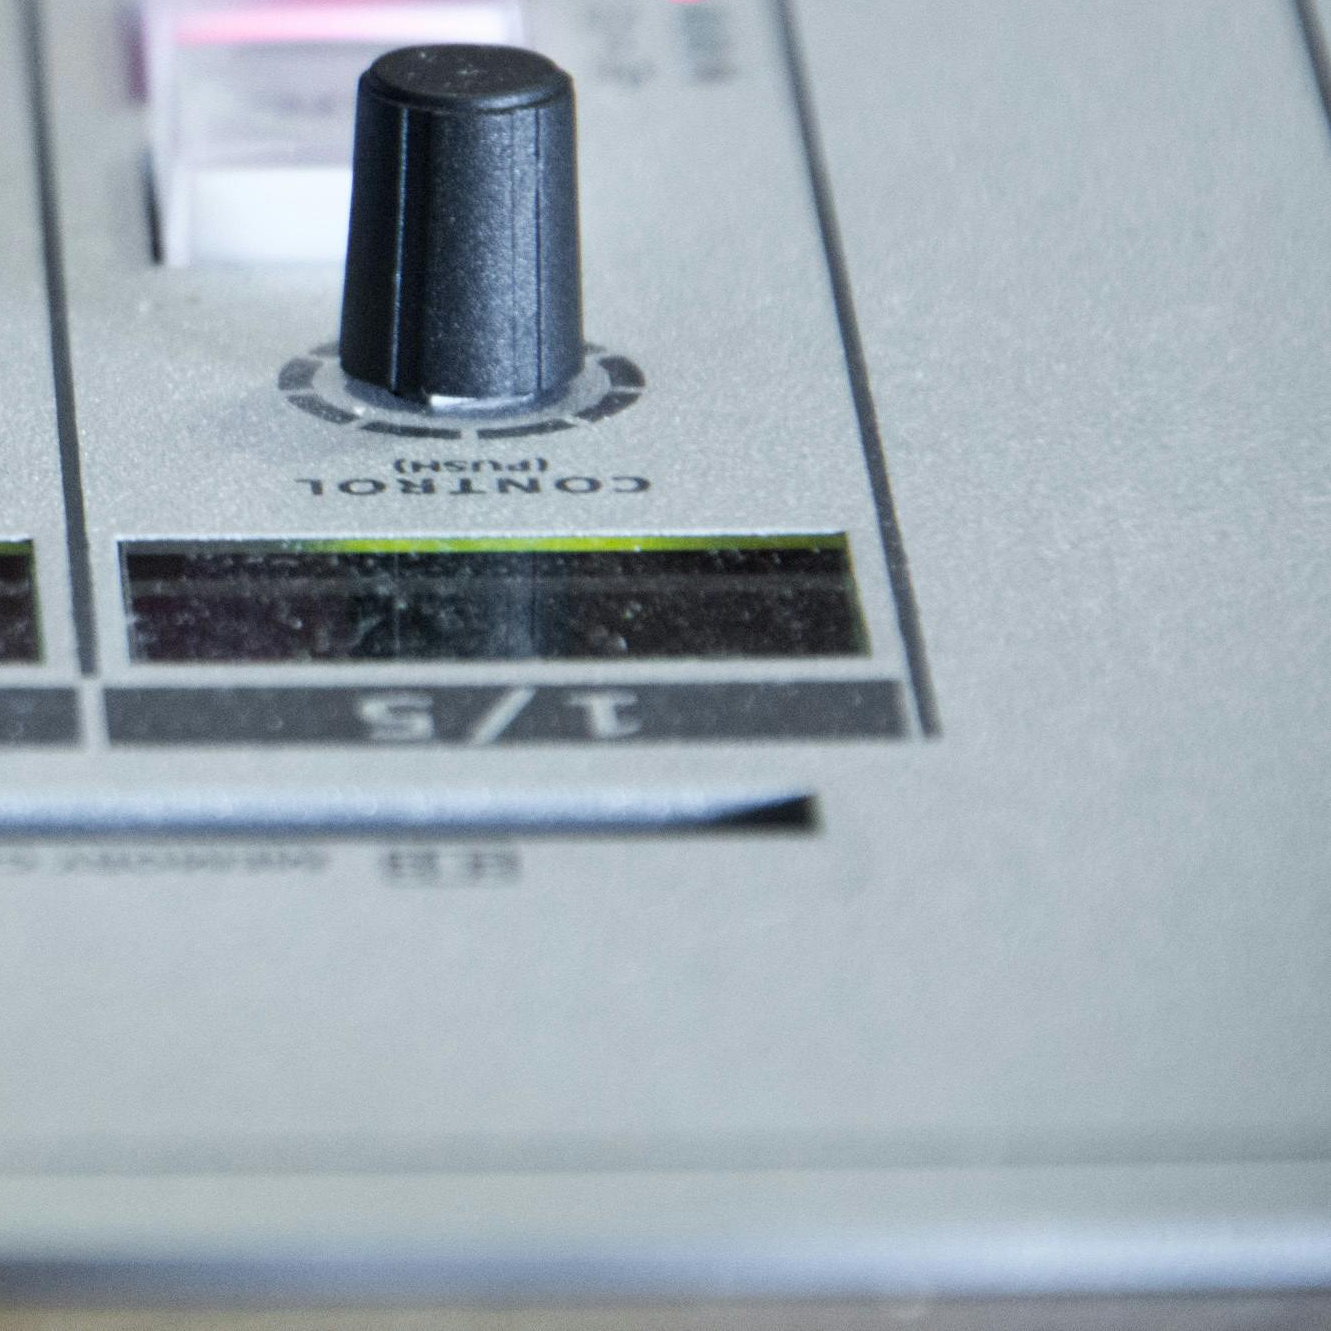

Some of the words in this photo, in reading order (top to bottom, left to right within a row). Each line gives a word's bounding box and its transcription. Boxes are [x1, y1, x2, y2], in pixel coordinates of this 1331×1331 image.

[392, 457, 549, 475] (PUSH)
[296, 475, 652, 497] CONTROL
[353, 686, 645, 746] 1/5
